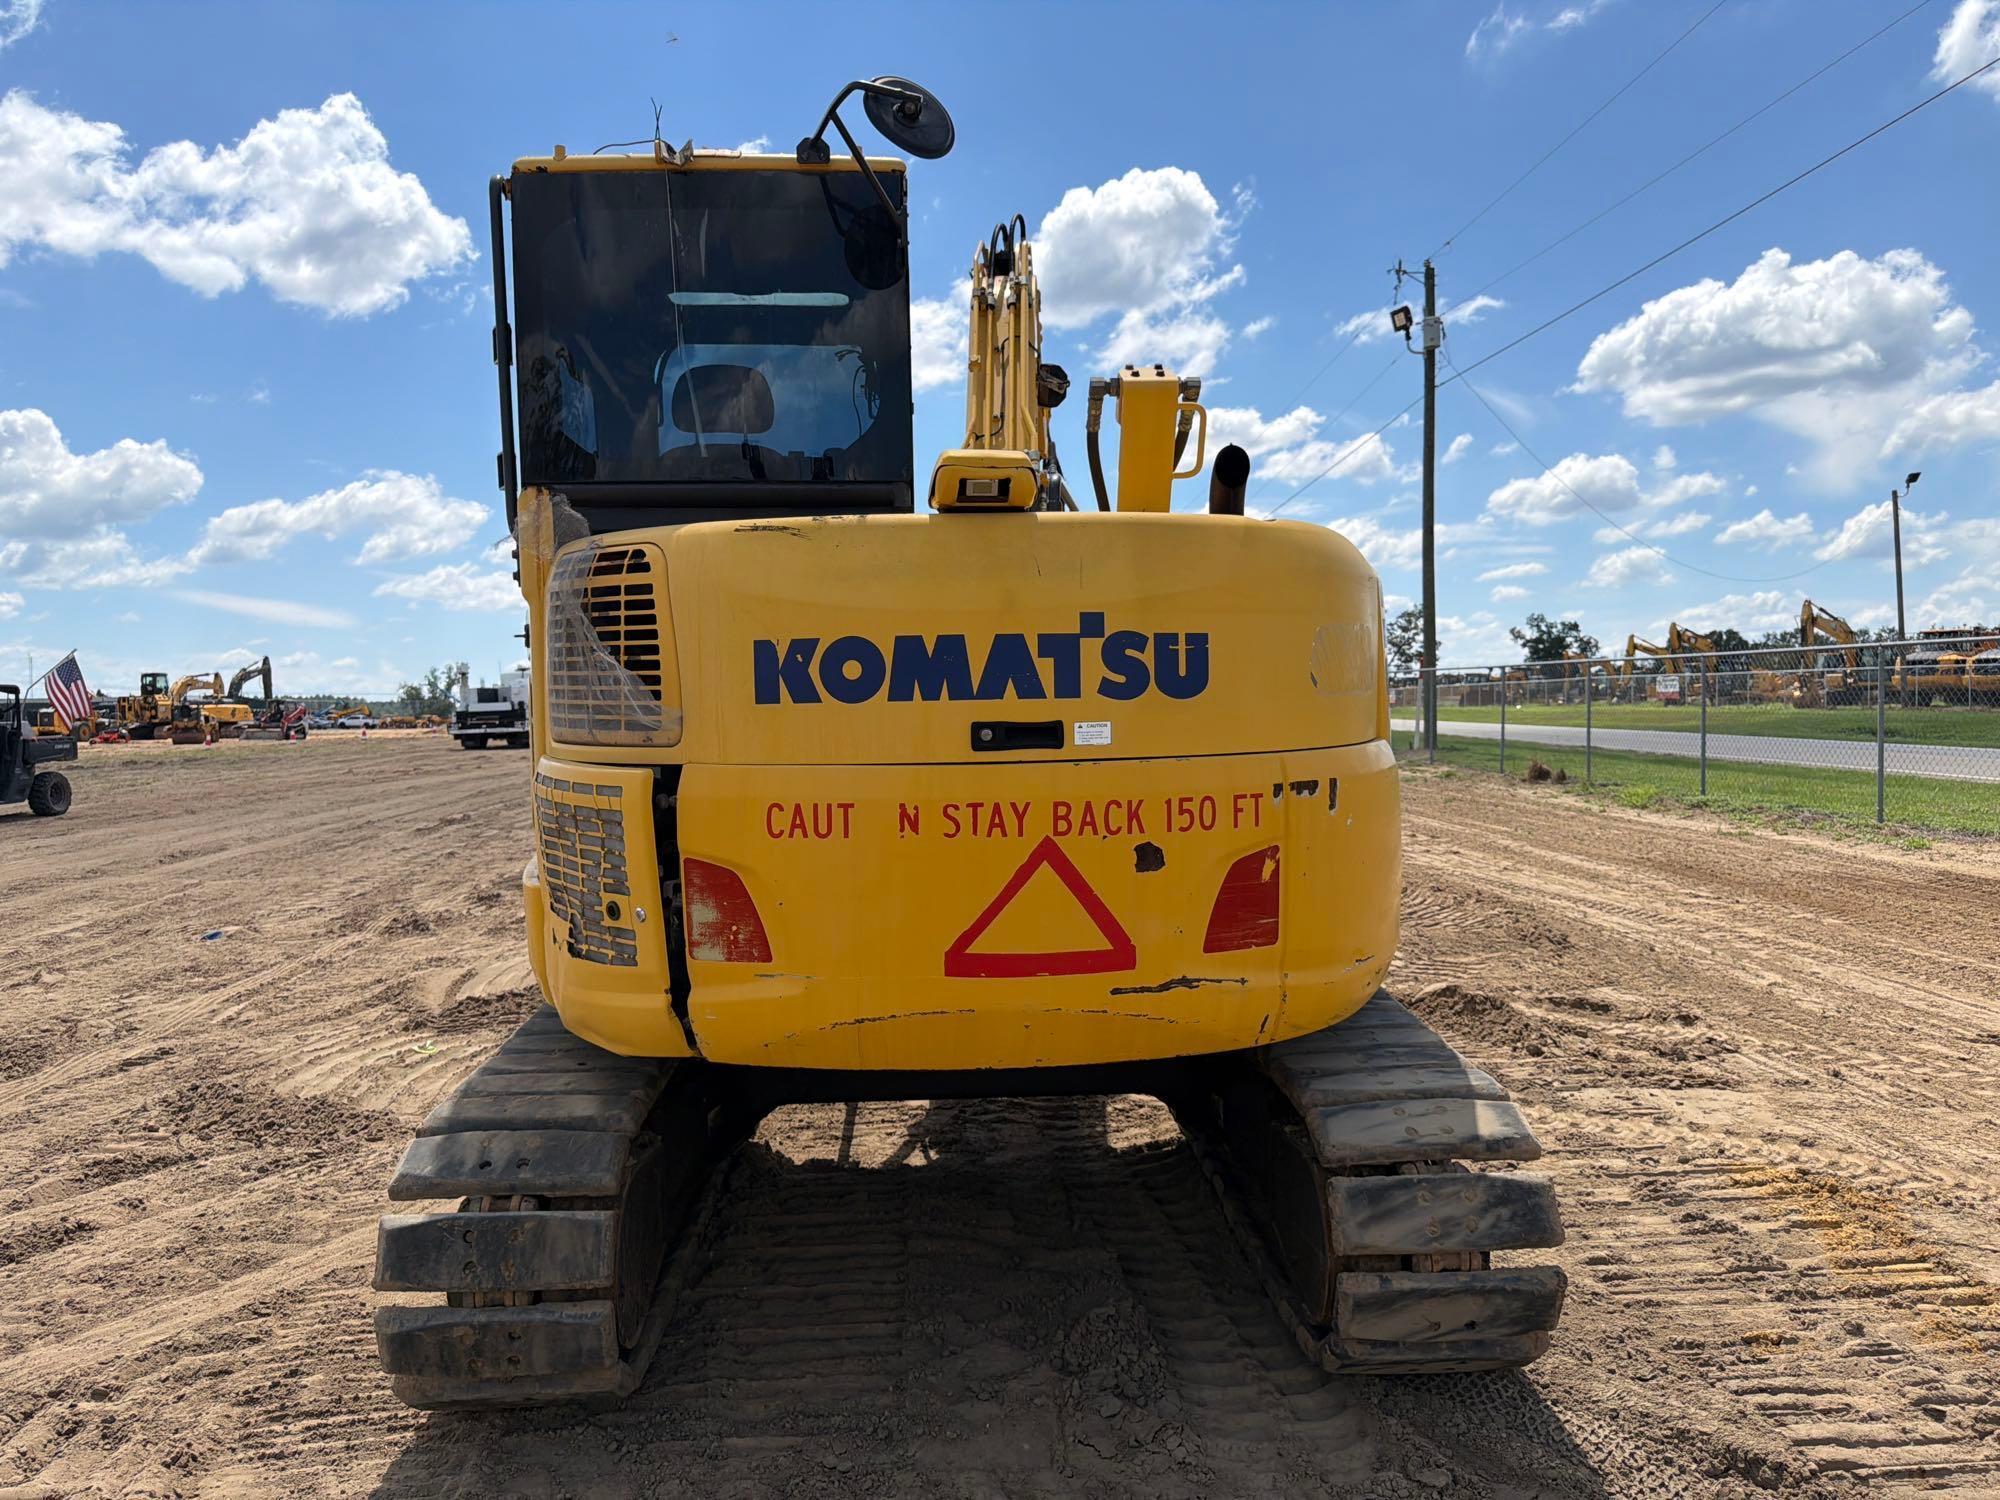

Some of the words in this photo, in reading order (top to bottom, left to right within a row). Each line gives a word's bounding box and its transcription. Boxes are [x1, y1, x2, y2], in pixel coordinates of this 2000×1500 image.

[754, 611, 1209, 705] KOMATSU
[942, 801, 1031, 839] STAY
[1052, 799, 1146, 838] BACK
[1165, 794, 1217, 833] 150
[1232, 792, 1263, 829] FT
